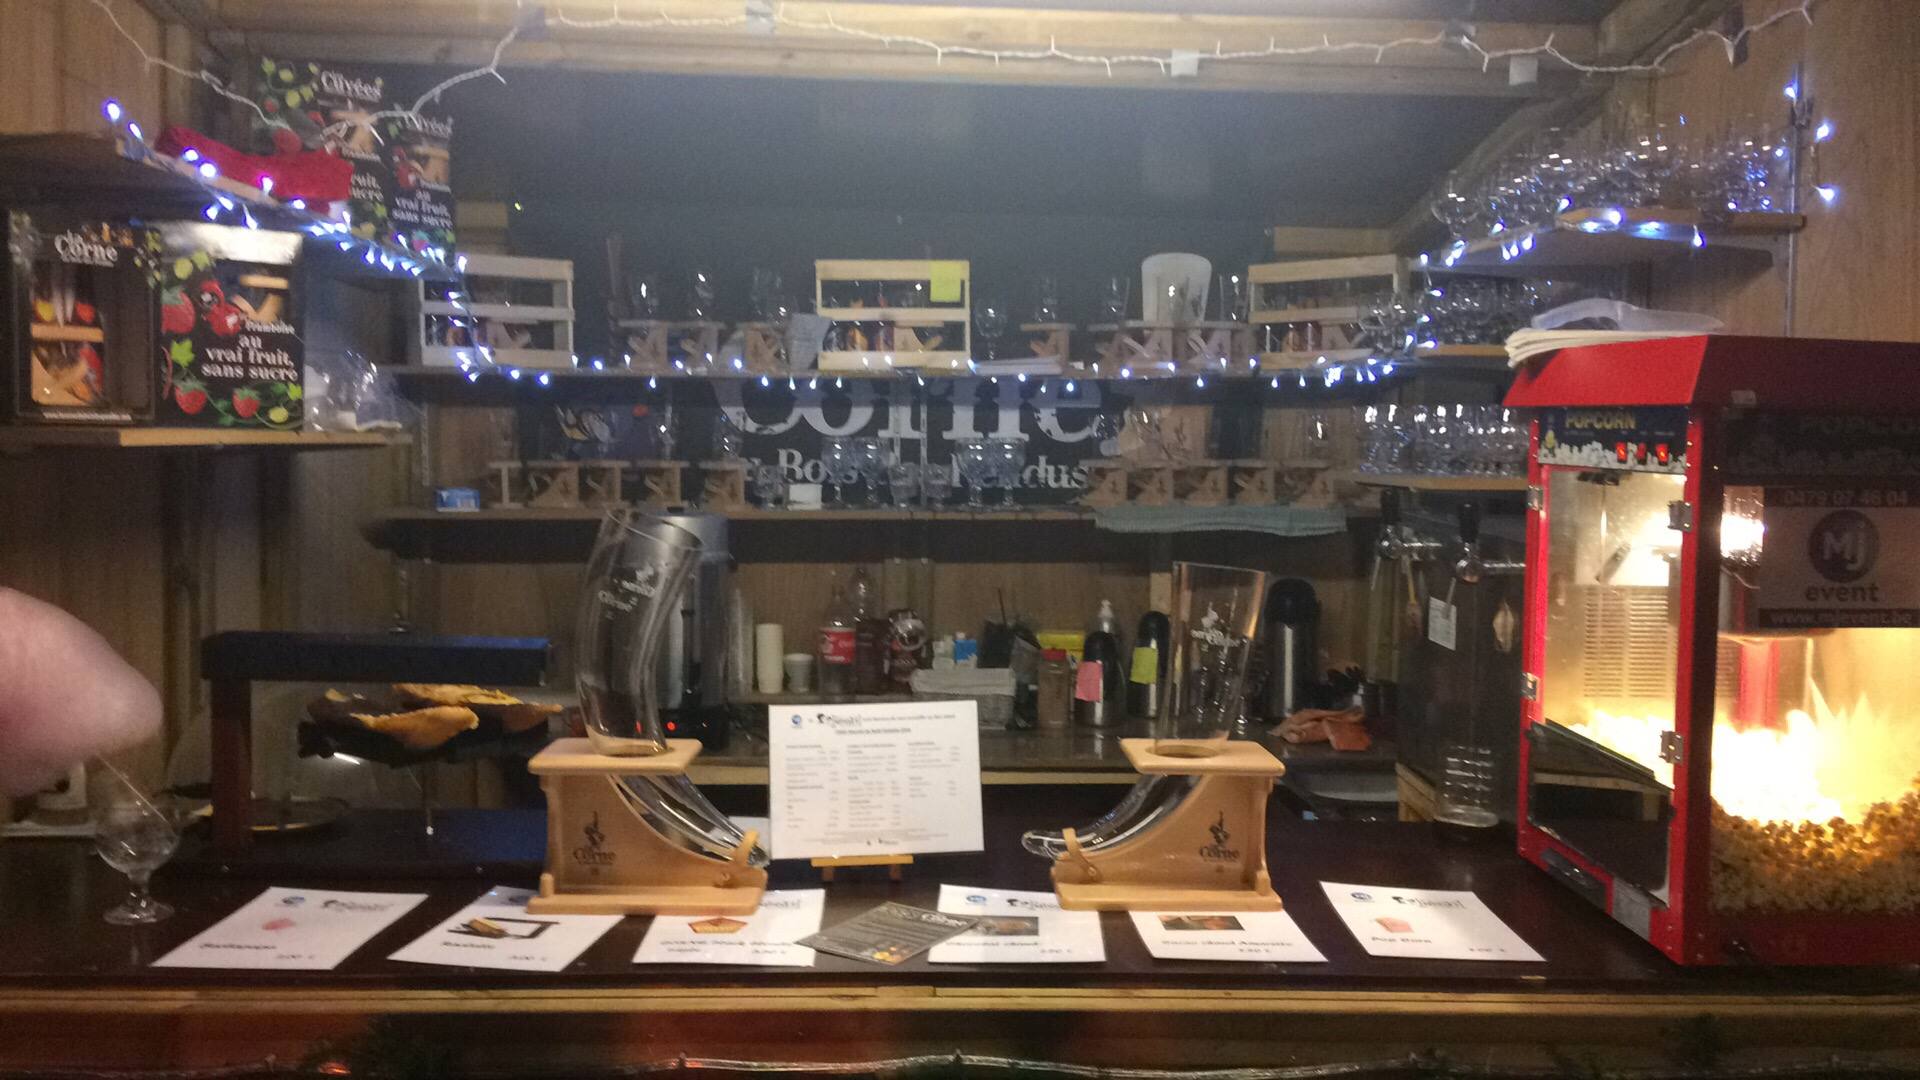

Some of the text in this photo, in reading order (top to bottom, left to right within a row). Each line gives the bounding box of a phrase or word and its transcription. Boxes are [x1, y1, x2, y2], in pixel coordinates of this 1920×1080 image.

[239, 334, 262, 349] au
[205, 346, 244, 363] vrai
[201, 363, 244, 379] sans
[1565, 411, 1636, 430] POPCORN
[1805, 583, 1879, 602] event
